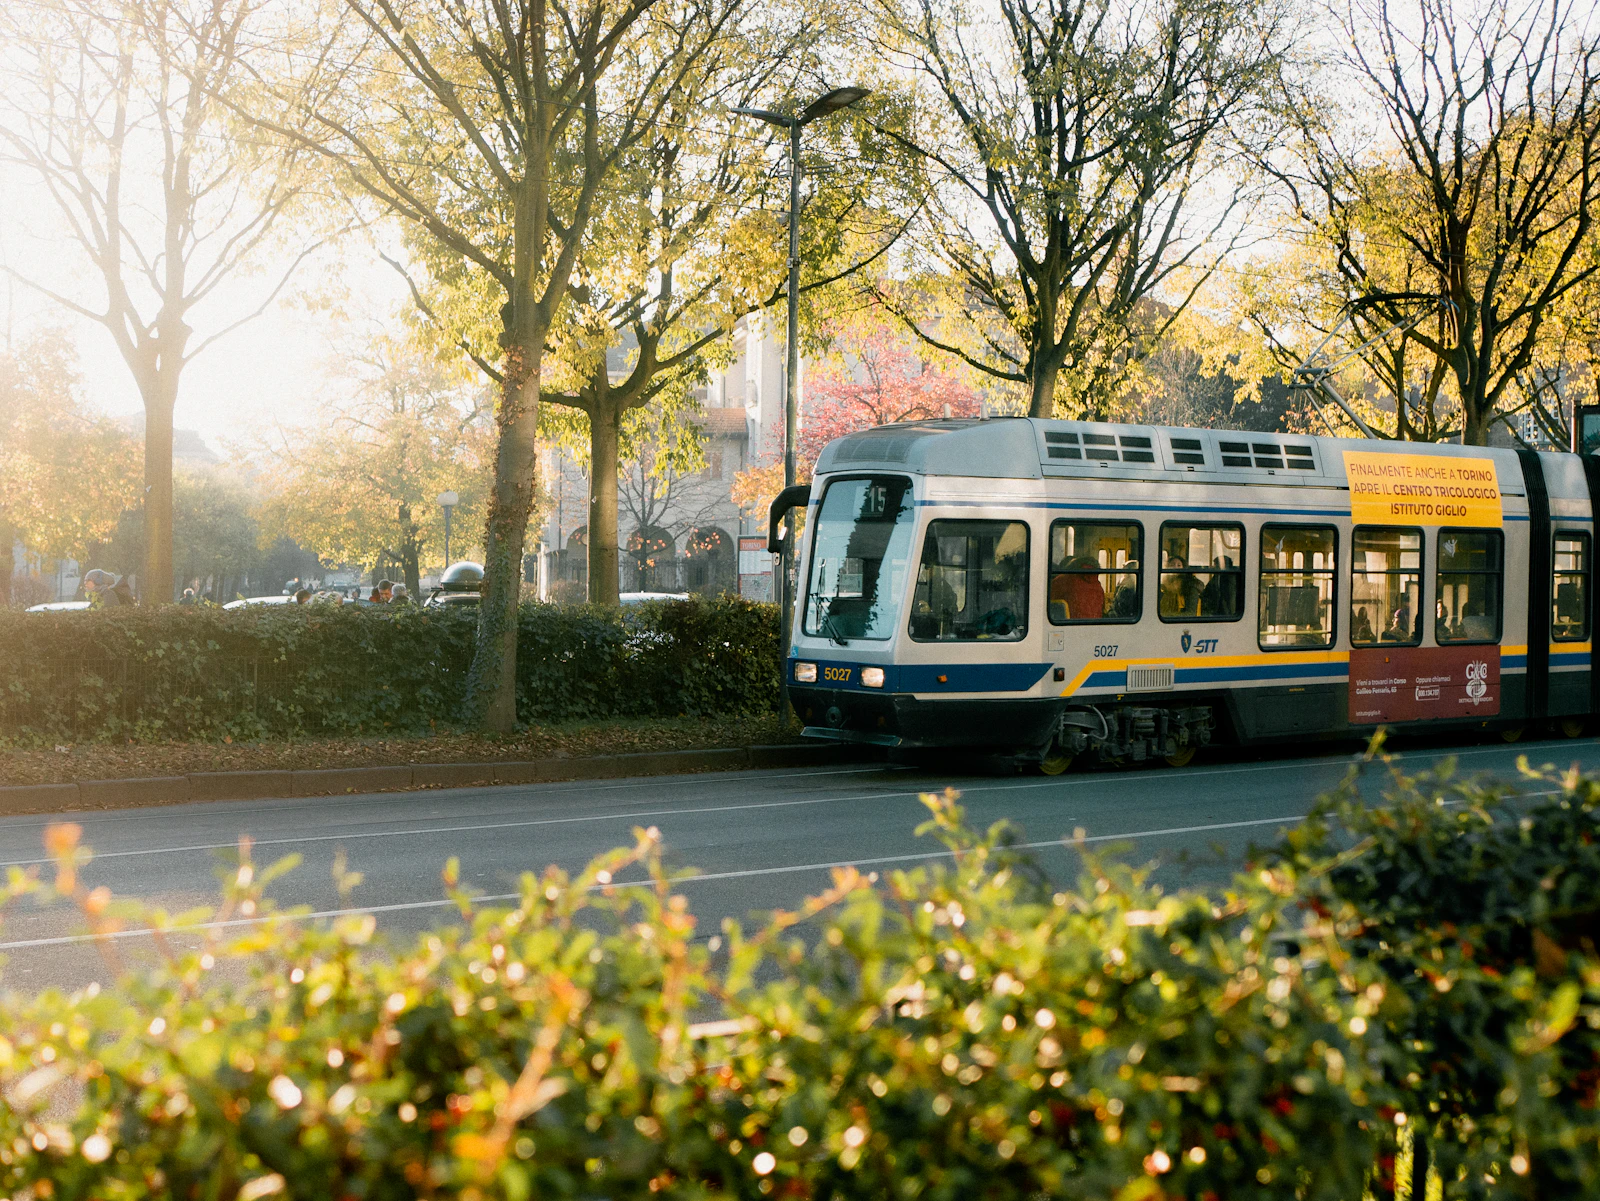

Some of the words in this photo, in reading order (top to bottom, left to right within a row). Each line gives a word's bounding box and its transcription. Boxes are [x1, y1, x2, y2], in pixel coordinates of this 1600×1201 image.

[1350, 463, 1412, 478] FINALMENTE
[1415, 467, 1447, 480] ANCHE
[1449, 469, 1457, 480] A
[1457, 469, 1492, 482] TORINO
[1354, 482, 1380, 495] APRE
[1382, 484, 1392, 496] IL
[1393, 484, 1433, 497] CENTRO
[1433, 486, 1497, 499] TRICOLOGICO
[869, 486, 887, 513] 15
[1391, 503, 1434, 516] ISTITUTO
[1435, 504, 1467, 517] GIGLIO
[1094, 645, 1119, 658] 5027
[824, 667, 852, 681] 5027
